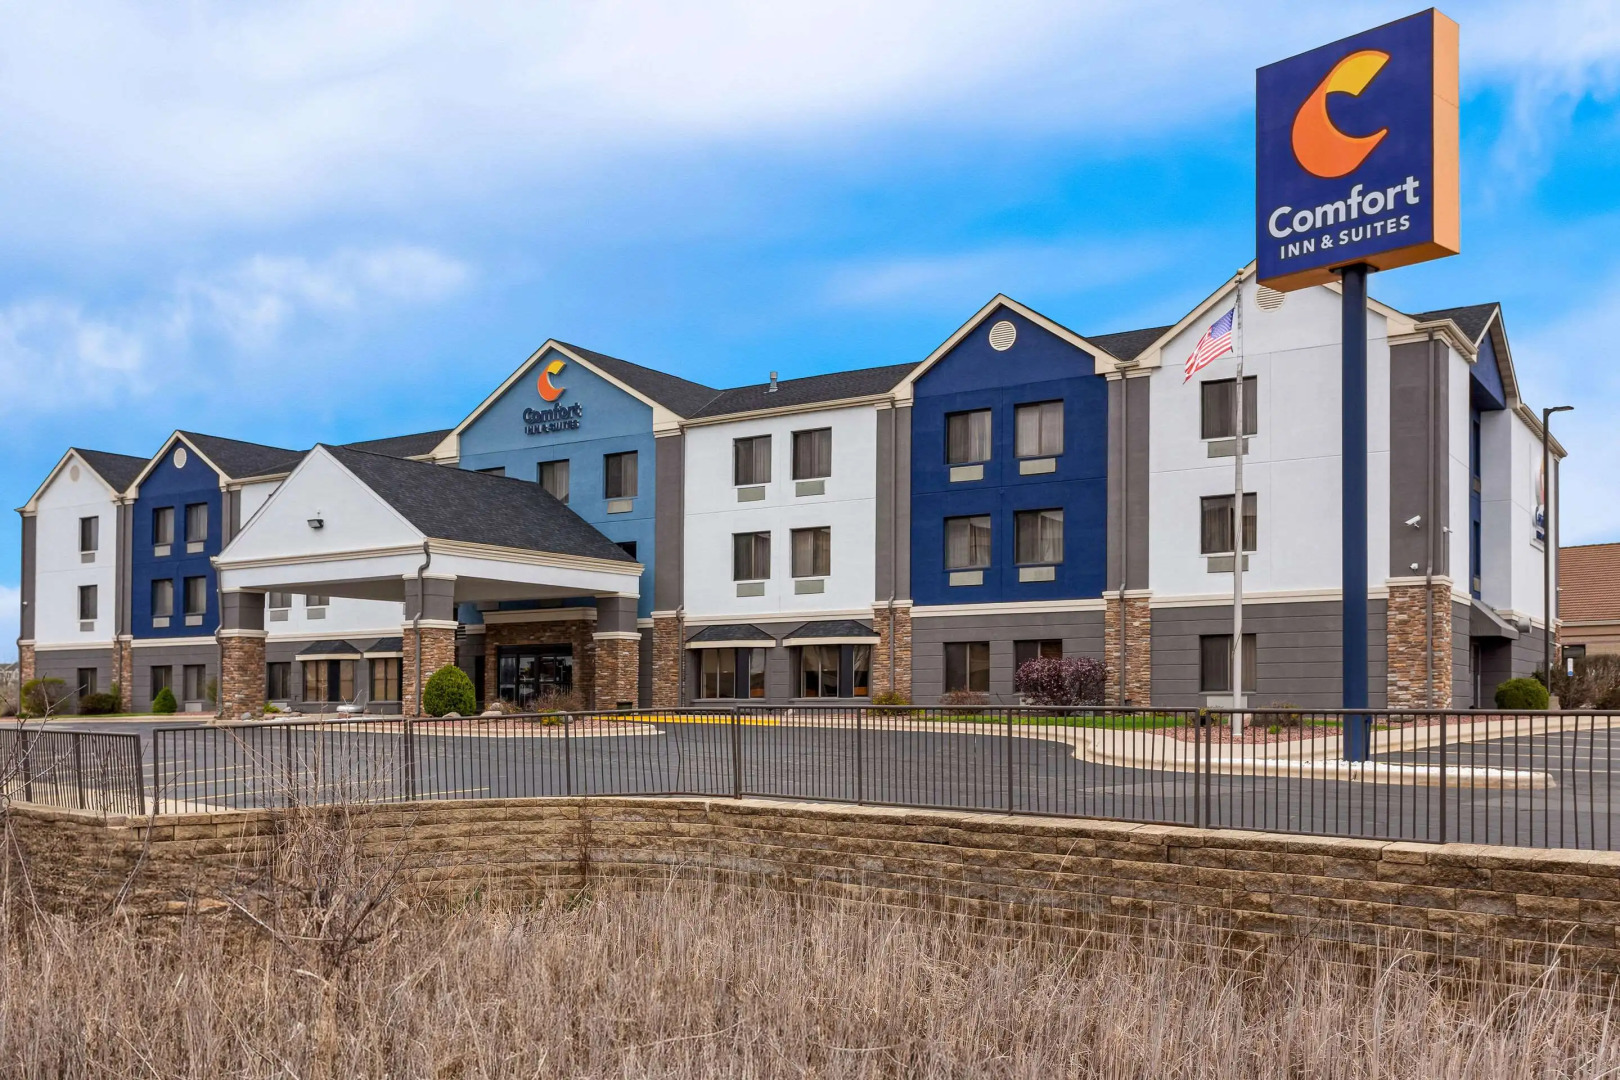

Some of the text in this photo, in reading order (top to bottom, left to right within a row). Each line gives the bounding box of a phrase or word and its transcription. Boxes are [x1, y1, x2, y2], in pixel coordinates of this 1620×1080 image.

[1268, 176, 1420, 239] Comfort
[1280, 215, 1411, 260] INN & SUITES
[523, 402, 582, 424] Comfort
